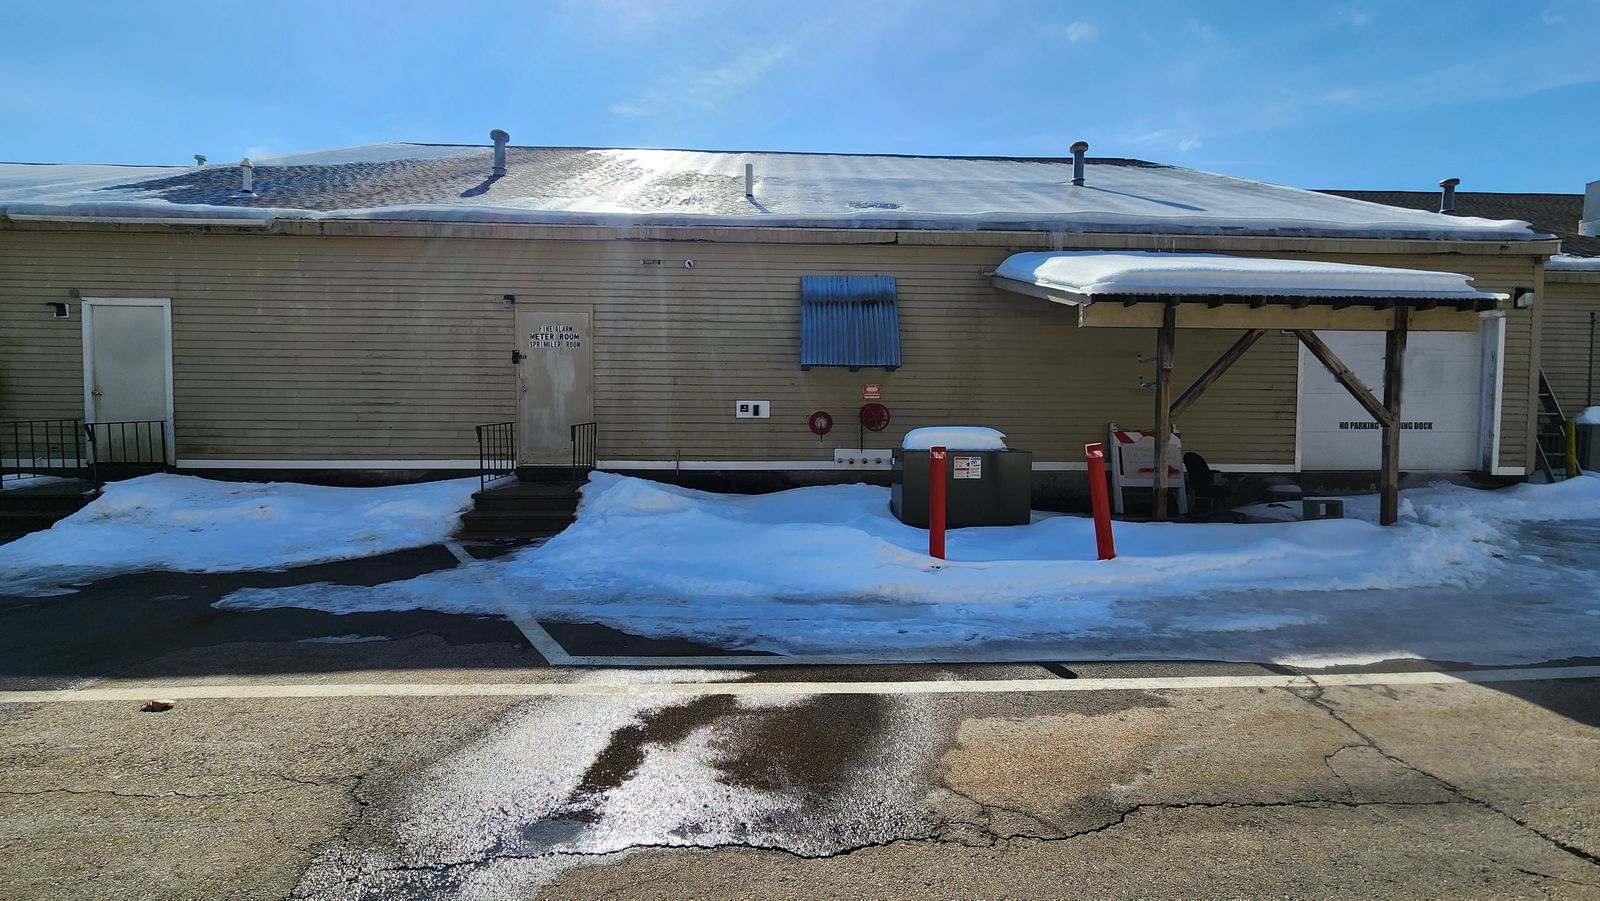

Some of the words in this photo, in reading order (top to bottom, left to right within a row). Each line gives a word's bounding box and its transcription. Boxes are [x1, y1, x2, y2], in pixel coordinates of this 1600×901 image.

[1339, 422, 1349, 430] NO
[1350, 422, 1379, 430] PARKING
[1414, 422, 1433, 430] DOCK
